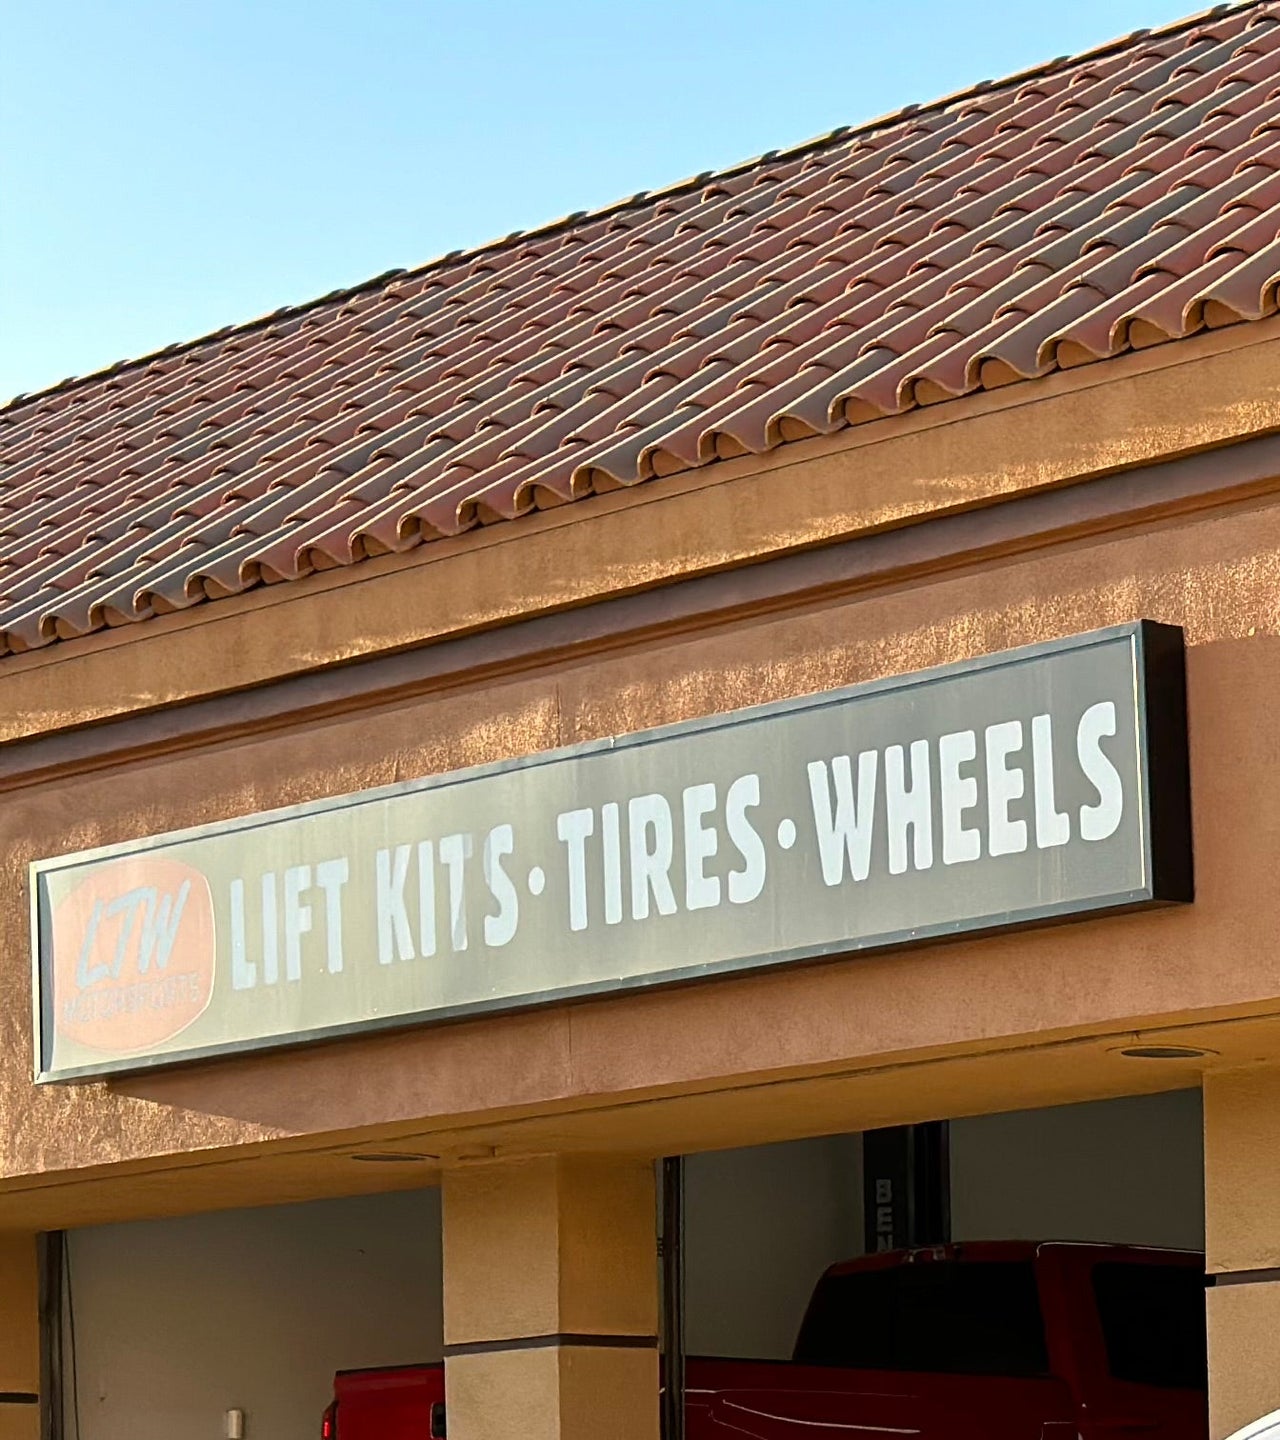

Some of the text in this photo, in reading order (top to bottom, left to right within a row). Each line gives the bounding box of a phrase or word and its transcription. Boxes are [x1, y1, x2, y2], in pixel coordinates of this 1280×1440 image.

[75, 879, 192, 990] LTW
[230, 701, 1123, 990] LIFT KITS TIRES WHEELS
